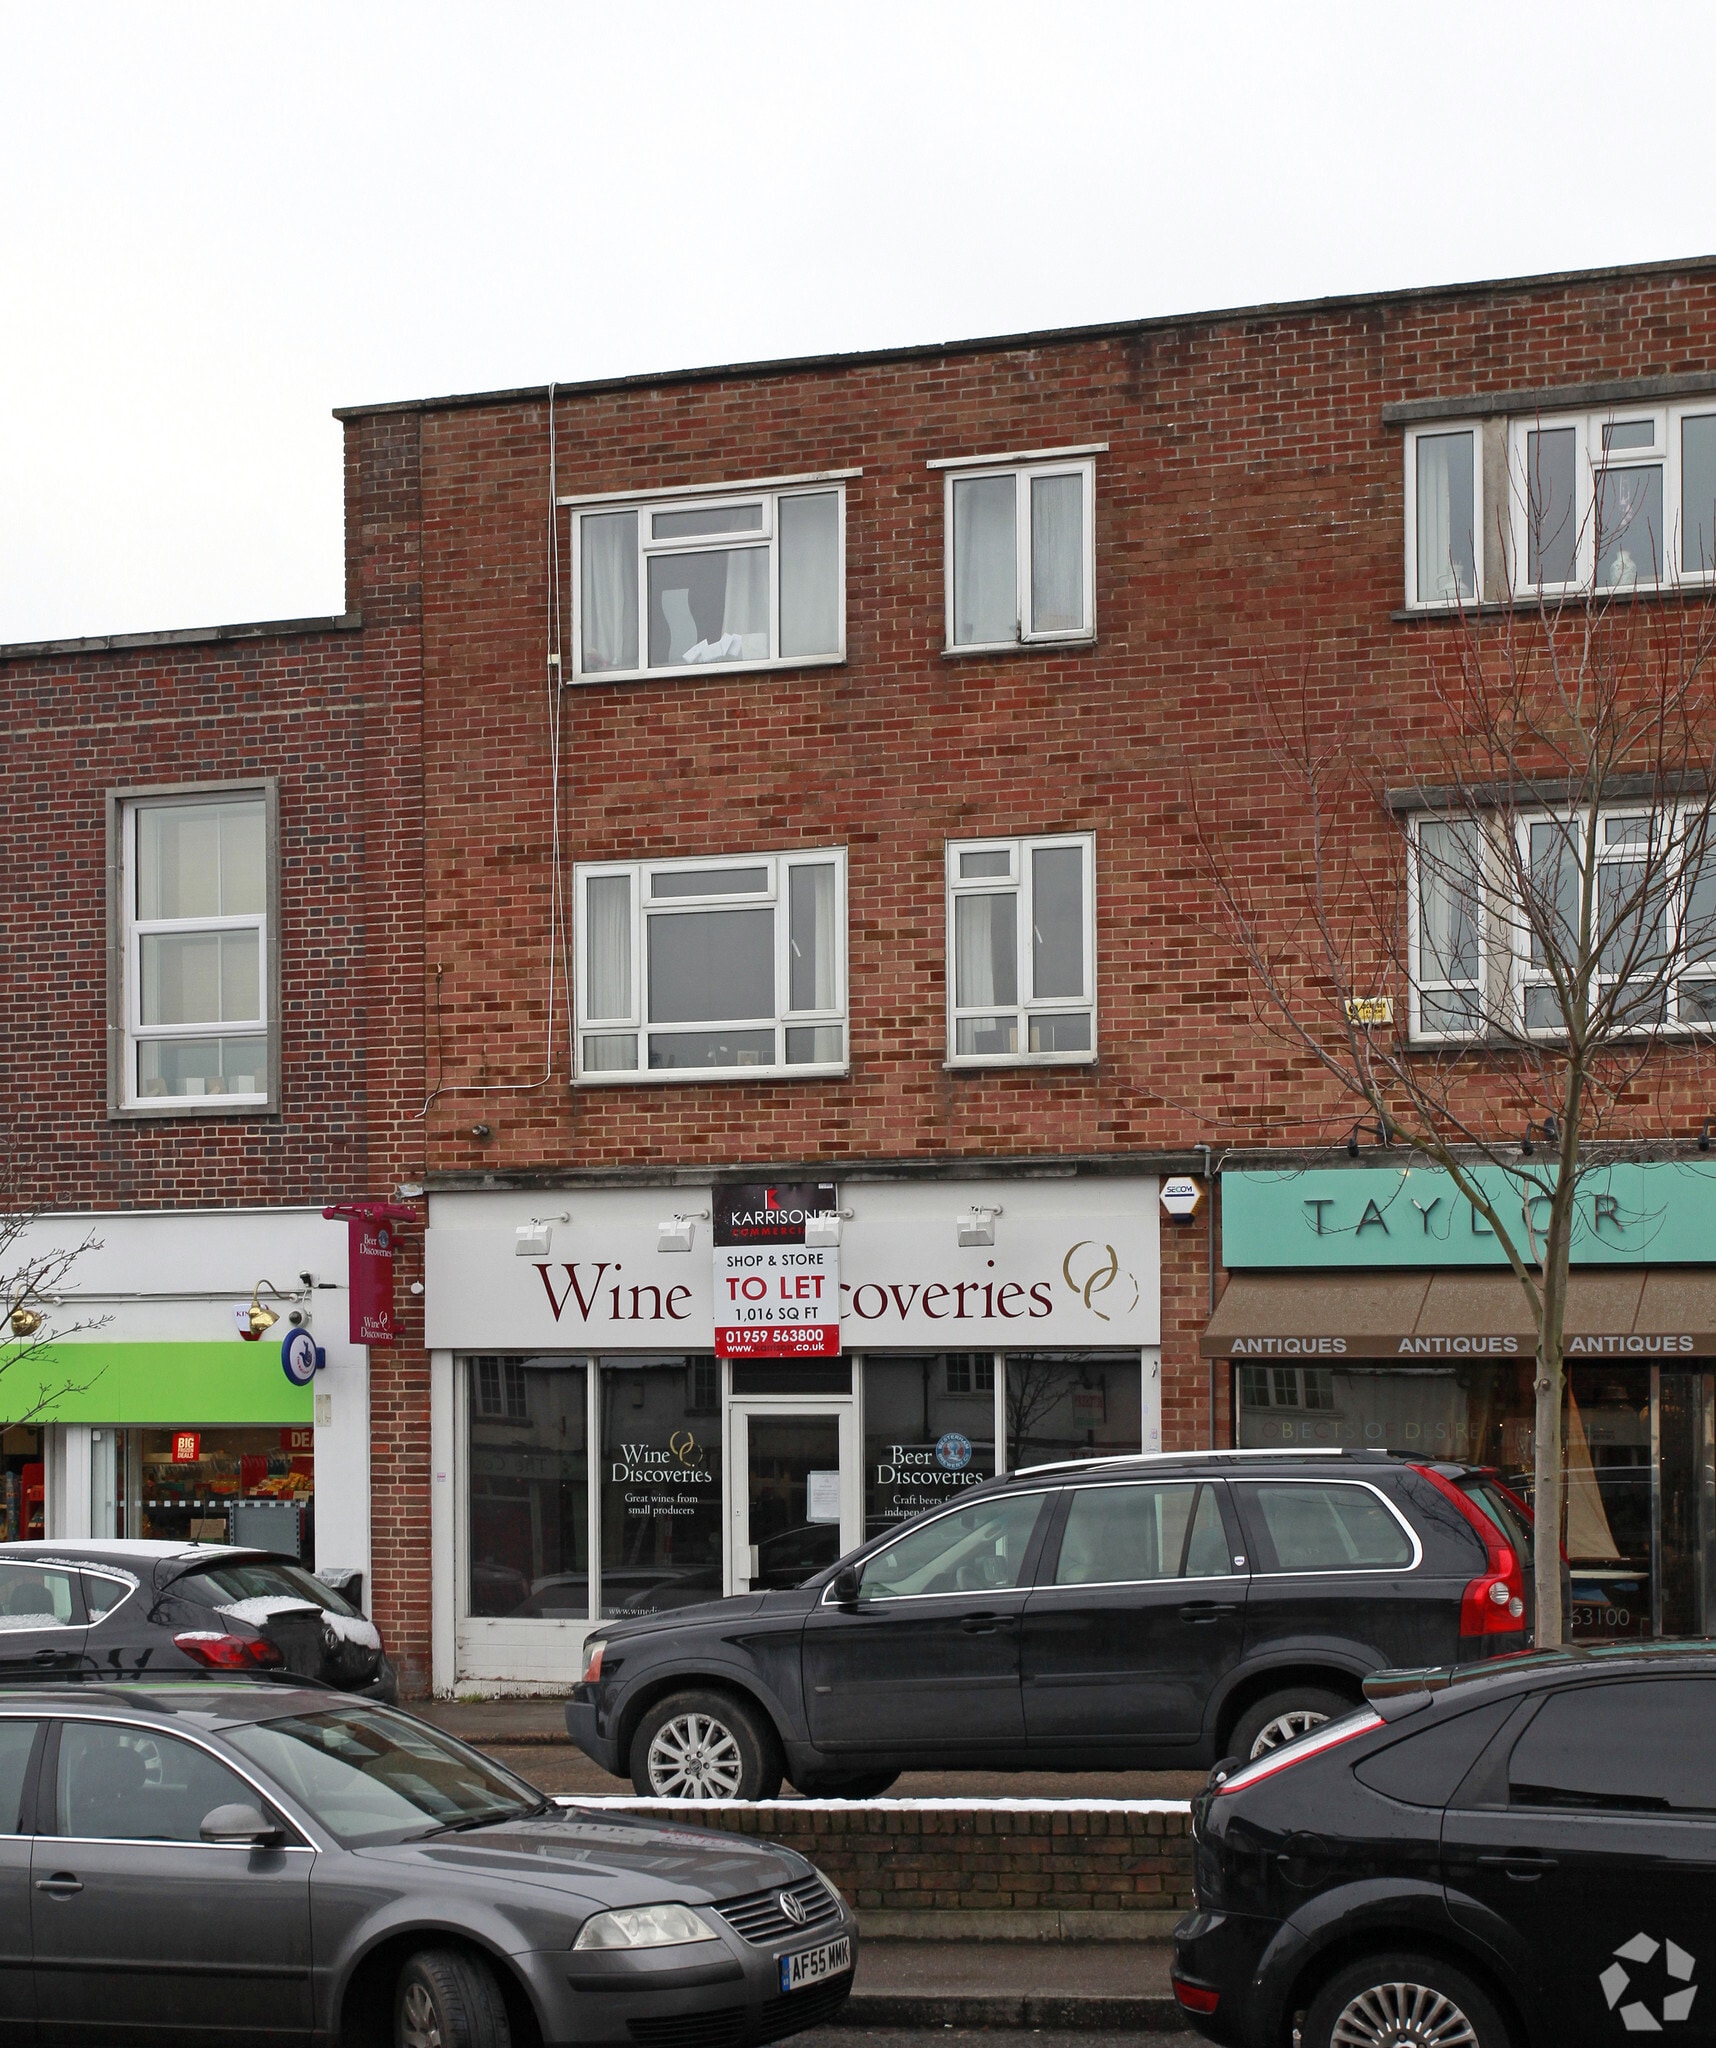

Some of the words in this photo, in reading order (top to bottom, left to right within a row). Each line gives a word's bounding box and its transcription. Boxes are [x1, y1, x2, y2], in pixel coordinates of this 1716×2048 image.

[731, 1209, 817, 1226] KARRISON
[1303, 1195, 1624, 1236] TAYLOR
[364, 1233, 377, 1245] Beer
[359, 1243, 392, 1258] Discoveries
[727, 1255, 763, 1267] SHOP
[768, 1255, 777, 1266] &
[782, 1253, 824, 1266] STORE
[532, 1263, 693, 1322] Wine
[726, 1276, 768, 1301] TO
[780, 1275, 825, 1300] LET
[735, 1308, 773, 1322] 1,016
[778, 1307, 799, 1320] SQ
[804, 1306, 818, 1319] FT
[363, 1316, 380, 1329] Wine
[360, 1326, 394, 1340] Discoveries
[725, 1330, 768, 1343] 01959
[772, 1329, 824, 1342] 563800
[1231, 1338, 1347, 1354] ANTIQUES
[1398, 1337, 1519, 1353] ANTIQUES
[1569, 1335, 1694, 1353] ANTIQUES
[1262, 1422, 1356, 1443] OBJECTS
[1405, 1422, 1482, 1440] DESIRE
[178, 1437, 195, 1448] BIG
[620, 1443, 671, 1463] Wine
[891, 1445, 933, 1465] Beer
[612, 1462, 713, 1483] Discoveries
[877, 1465, 984, 1485] Discoveries
[624, 1493, 649, 1503] Great
[651, 1494, 675, 1503] wines
[677, 1493, 698, 1503] from
[892, 1495, 917, 1504] Craft
[919, 1495, 942, 1504] beers
[628, 1505, 651, 1515] small
[653, 1505, 695, 1518] producers
[793, 1948, 826, 1982] AF55
[829, 1939, 849, 1970] MMK
